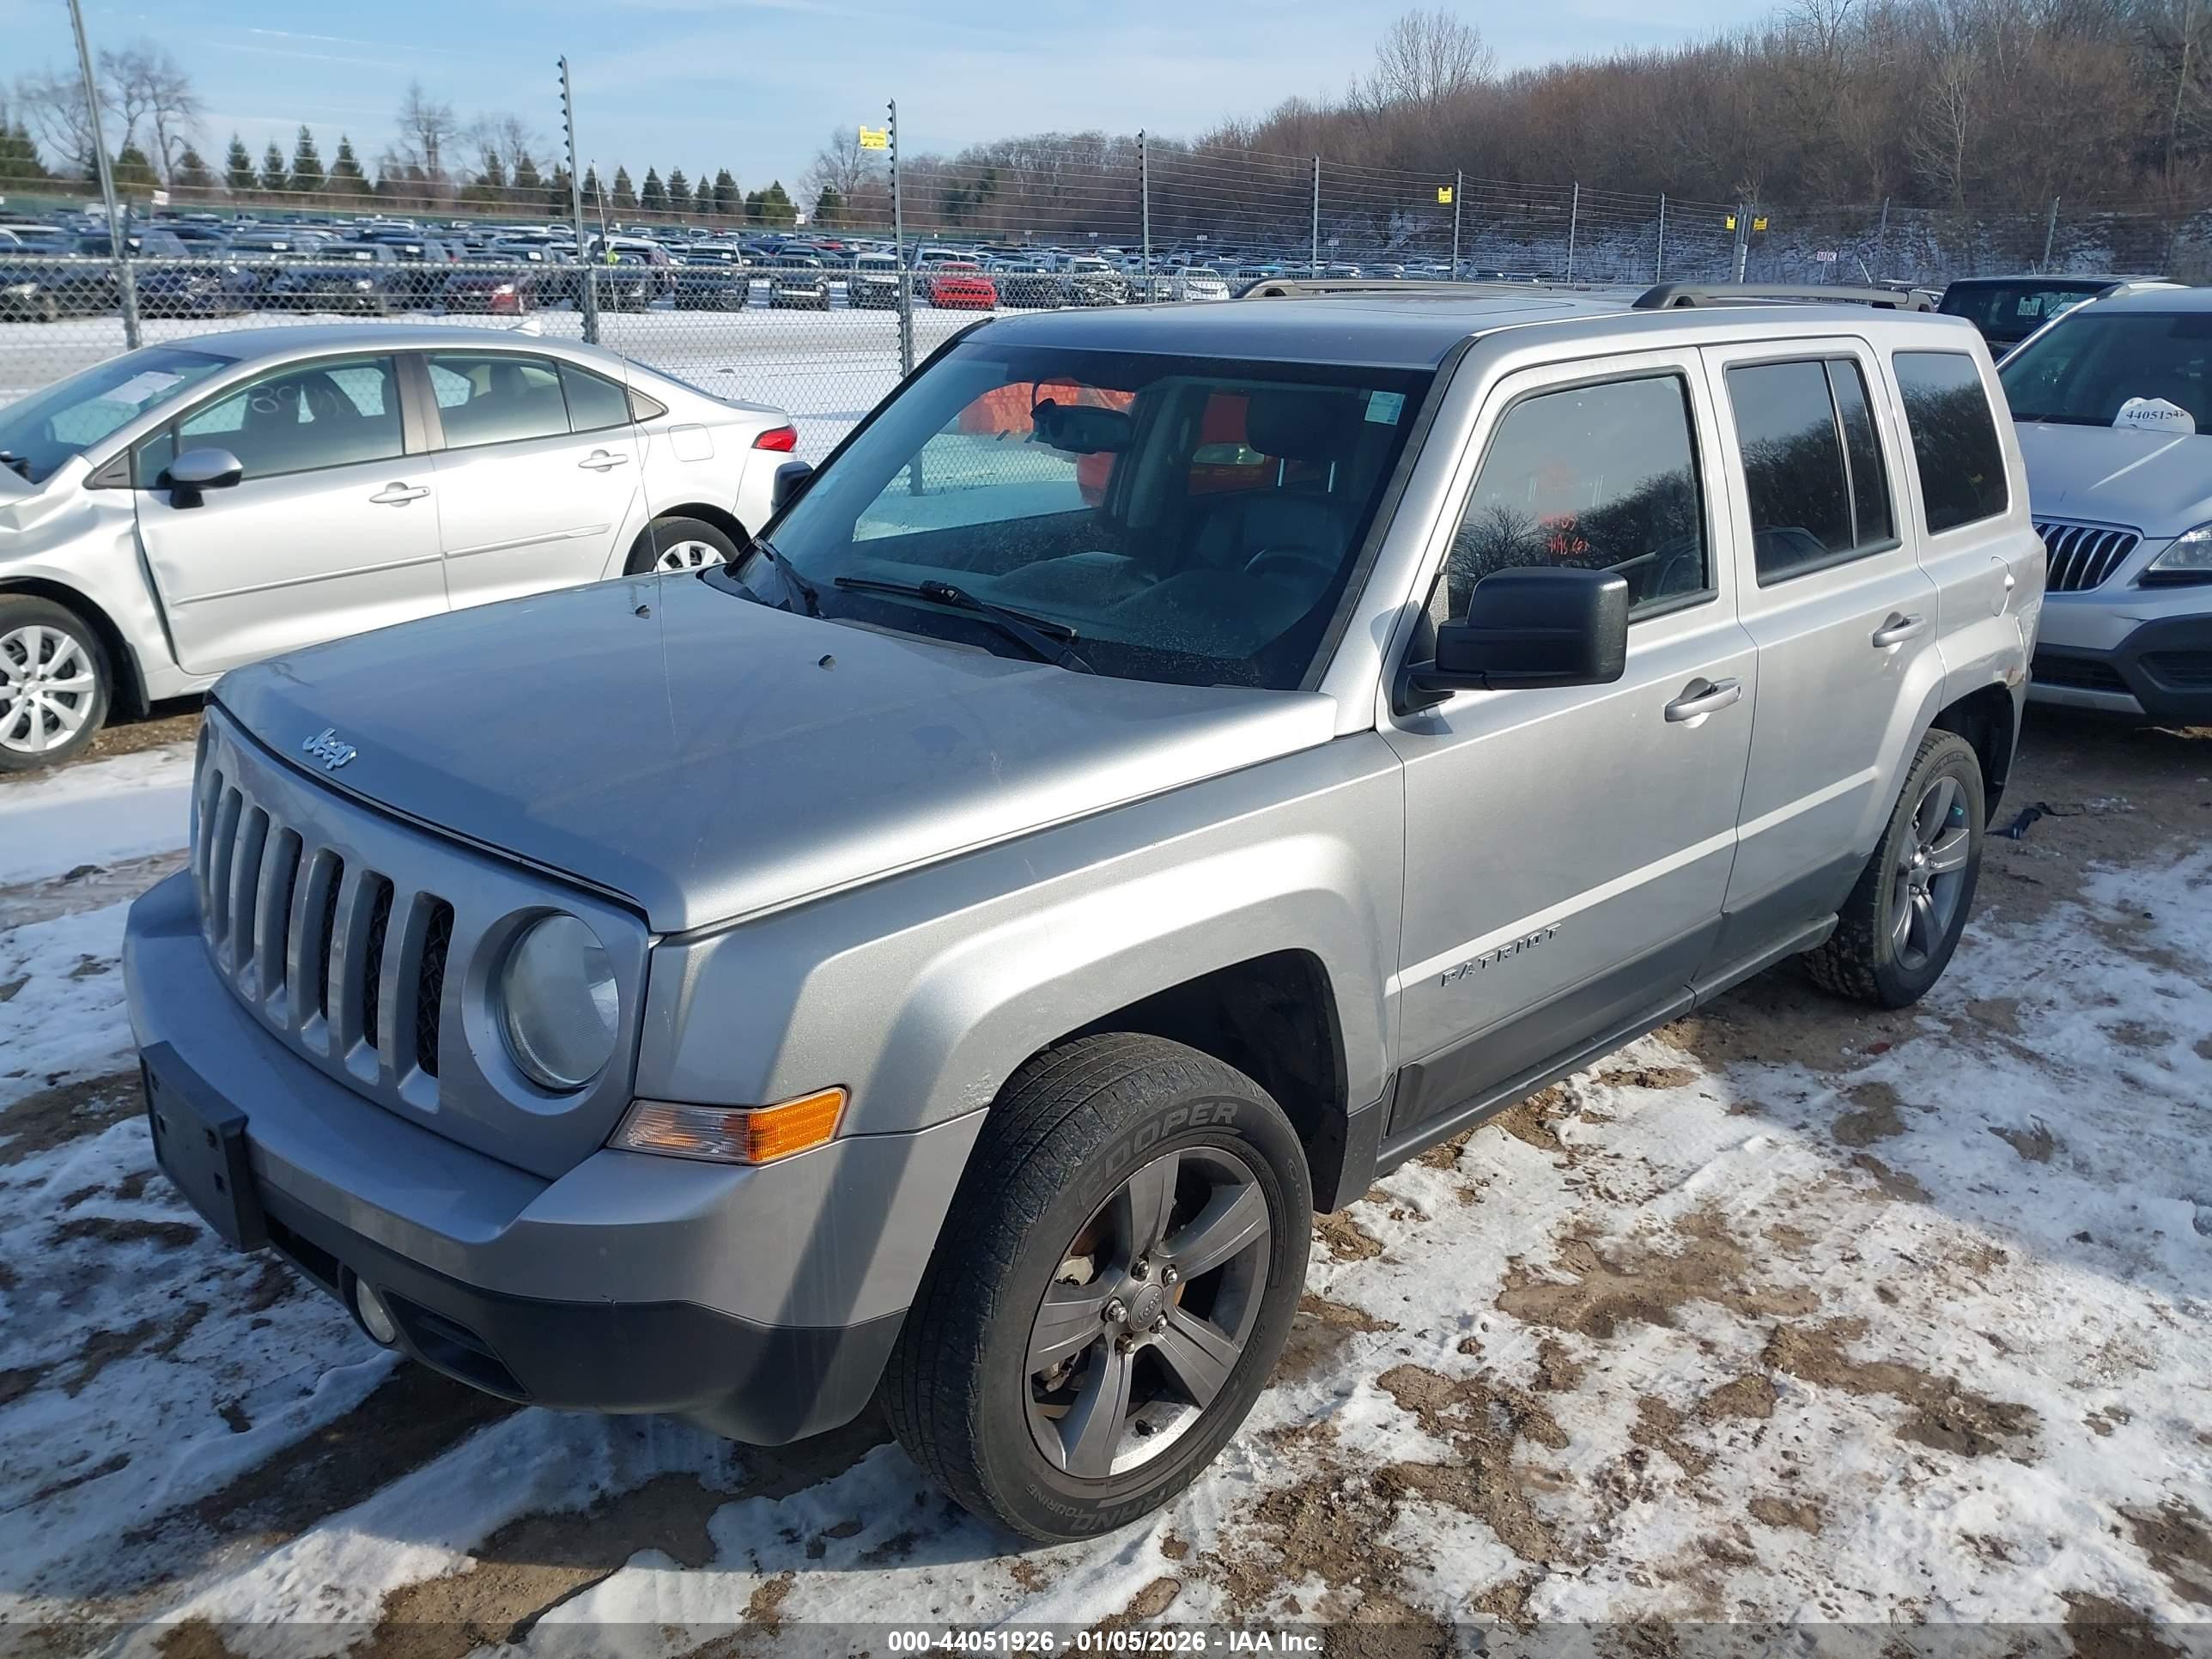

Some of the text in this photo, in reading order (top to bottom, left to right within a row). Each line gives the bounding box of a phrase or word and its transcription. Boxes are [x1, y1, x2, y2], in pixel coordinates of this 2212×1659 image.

[303, 727, 357, 770] Jeep
[1441, 922, 1562, 987] PATRIOT
[1073, 1102, 1239, 1208] COOPER
